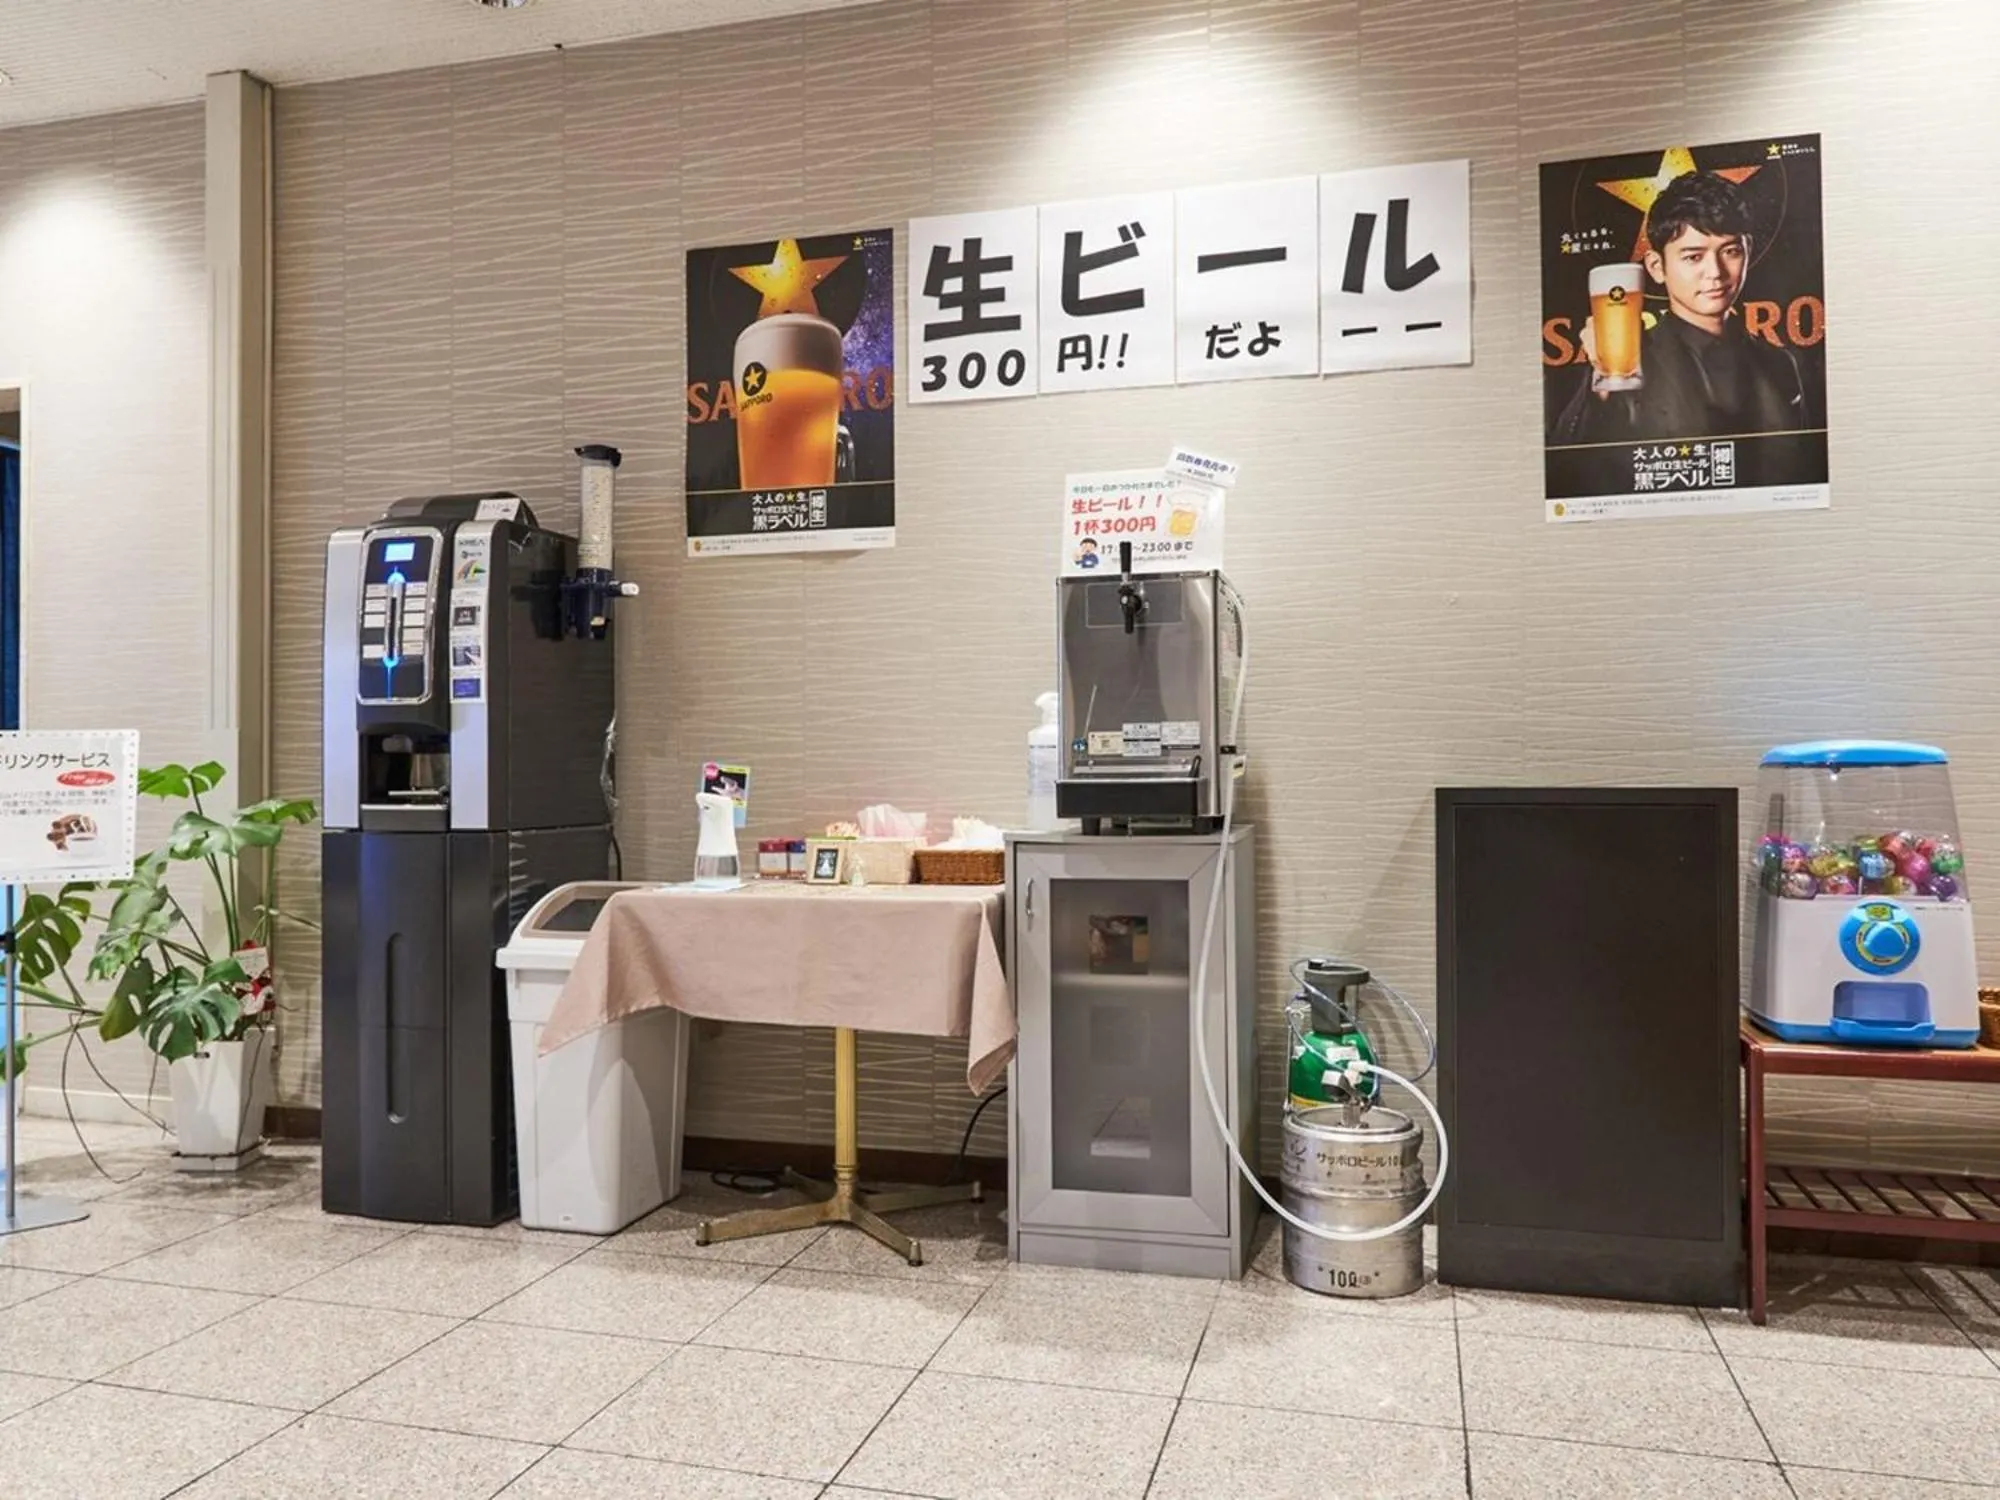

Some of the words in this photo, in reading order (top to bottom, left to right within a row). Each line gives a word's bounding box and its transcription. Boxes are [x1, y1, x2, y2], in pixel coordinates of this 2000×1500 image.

[1634, 470, 1710, 491] 黒ラベル
[752, 513, 808, 531] 黒ラベル
[1074, 515, 1156, 536] 1杯300円
